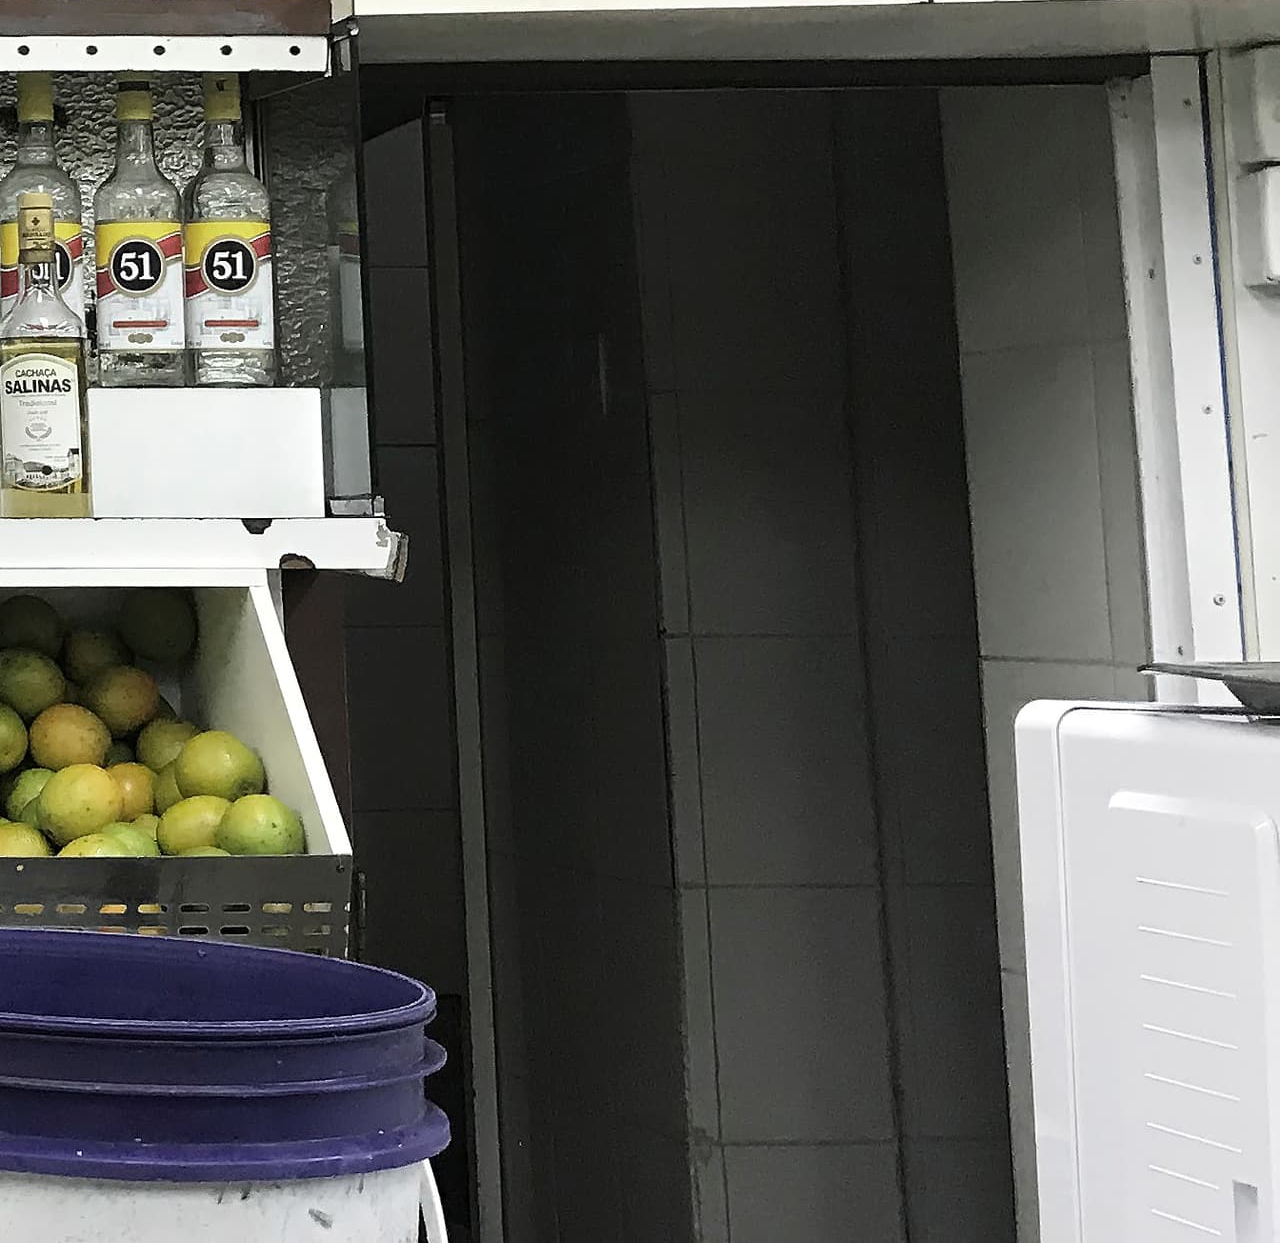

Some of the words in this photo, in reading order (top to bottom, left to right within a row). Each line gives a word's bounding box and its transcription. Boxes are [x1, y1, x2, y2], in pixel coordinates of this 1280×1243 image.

[119, 252, 154, 281] 51
[212, 251, 248, 281] 51
[15, 368, 56, 377] CACHAÇA
[5, 379, 71, 394] SALINAS
